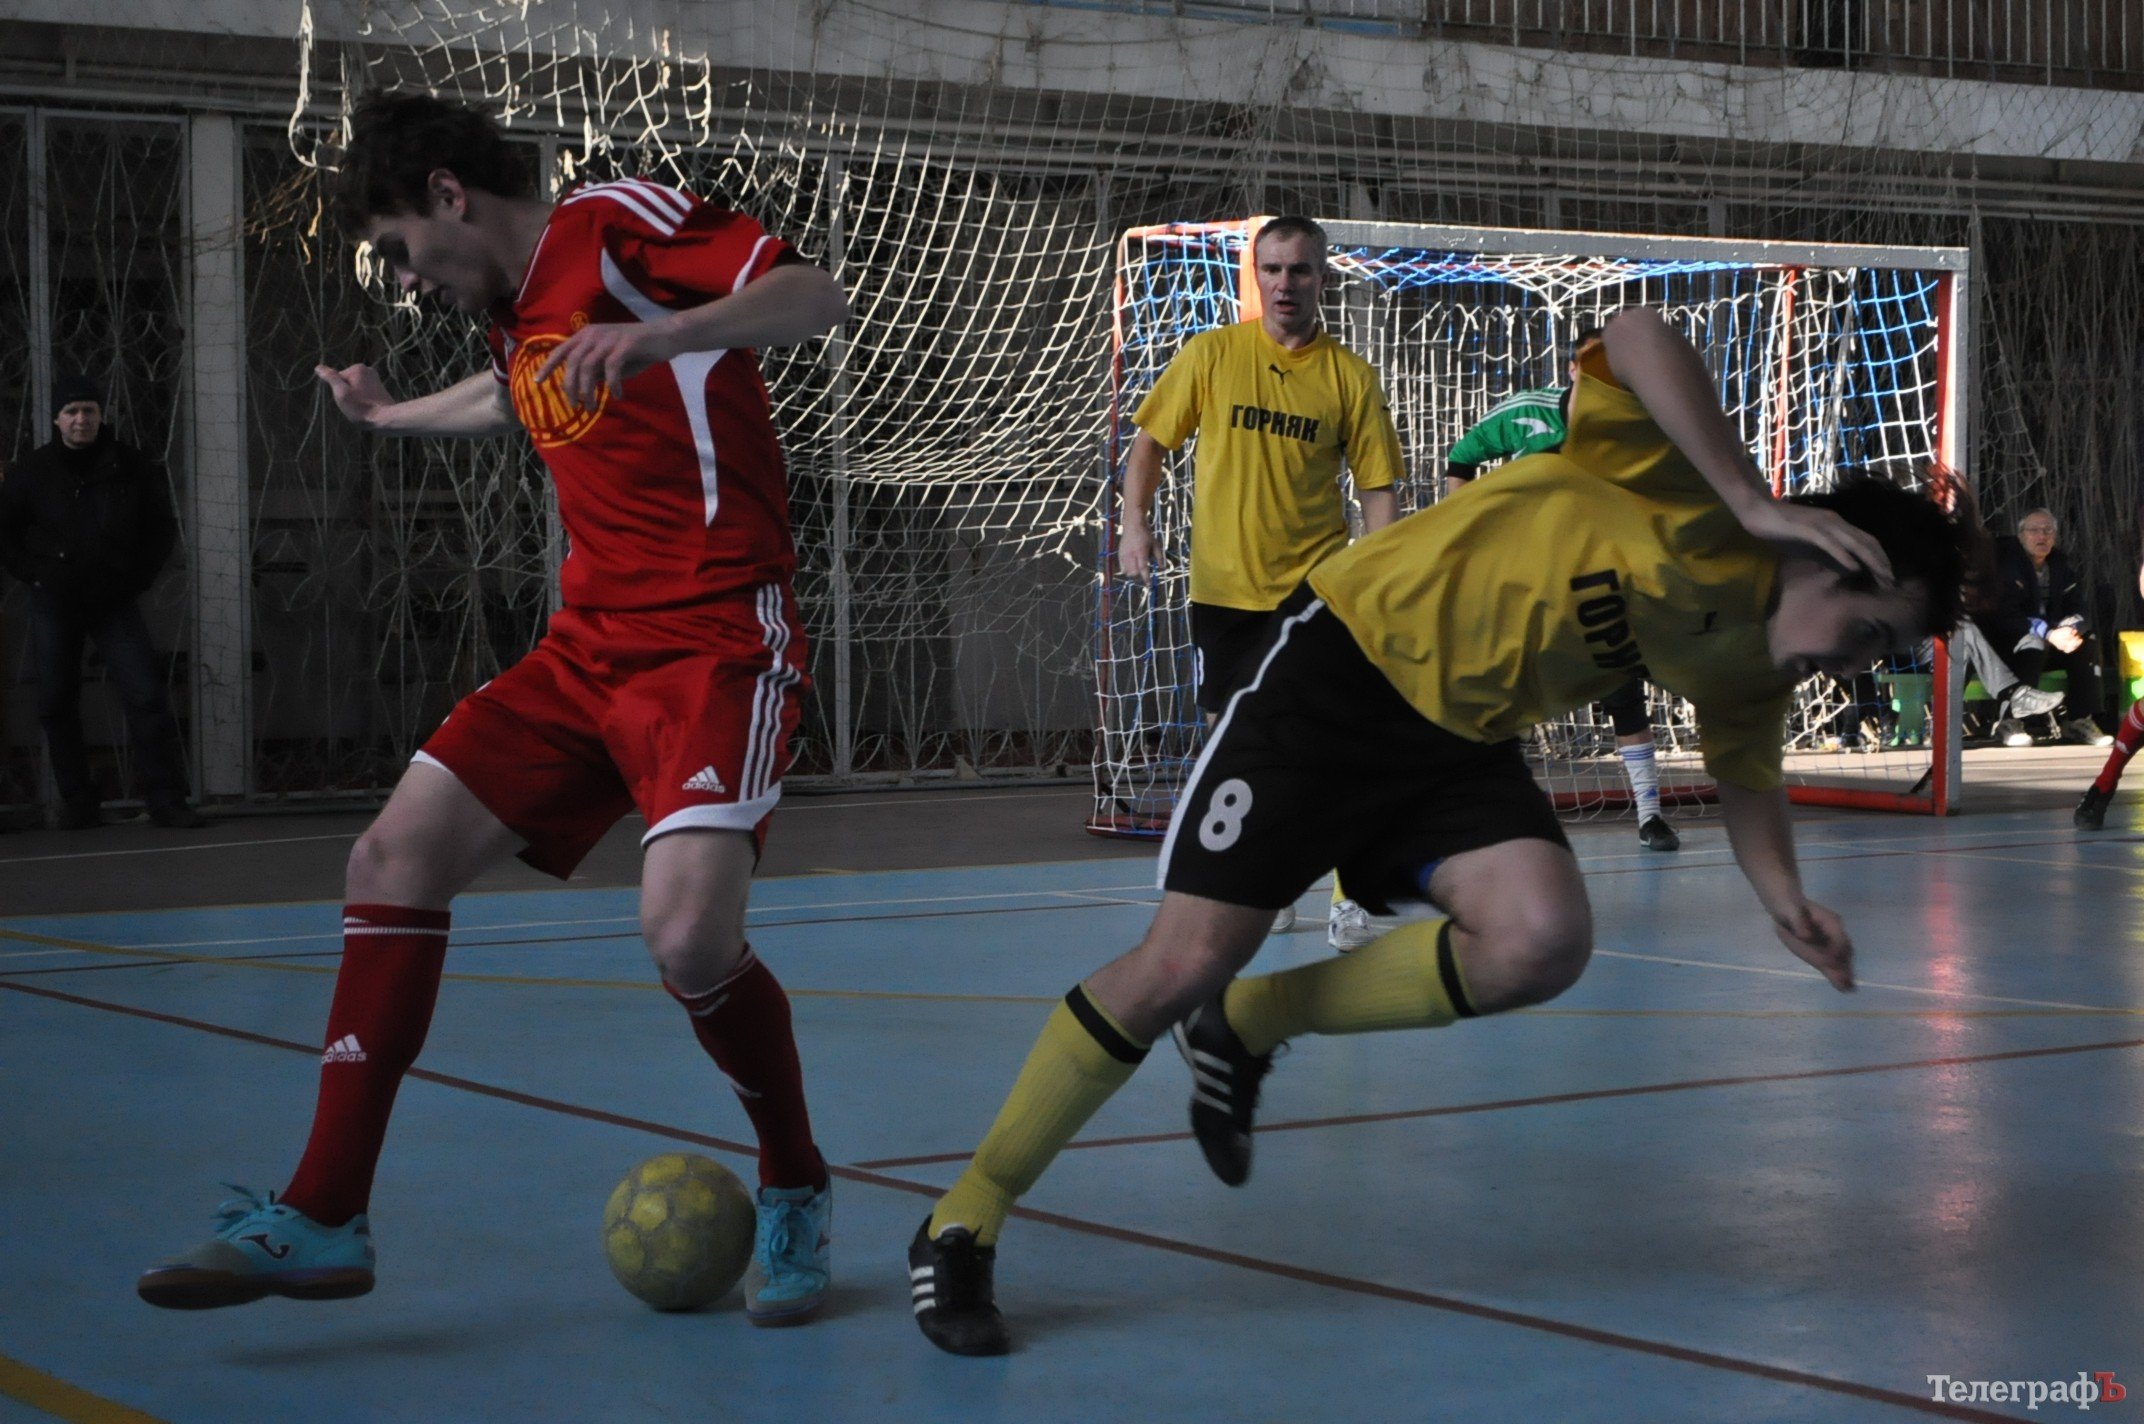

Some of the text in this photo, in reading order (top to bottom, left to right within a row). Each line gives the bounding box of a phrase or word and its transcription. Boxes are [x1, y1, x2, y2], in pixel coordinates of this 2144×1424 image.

[1231, 404, 1320, 443] ГОРНЯК
[681, 780, 726, 794] adidas
[1198, 778, 1254, 852] 8
